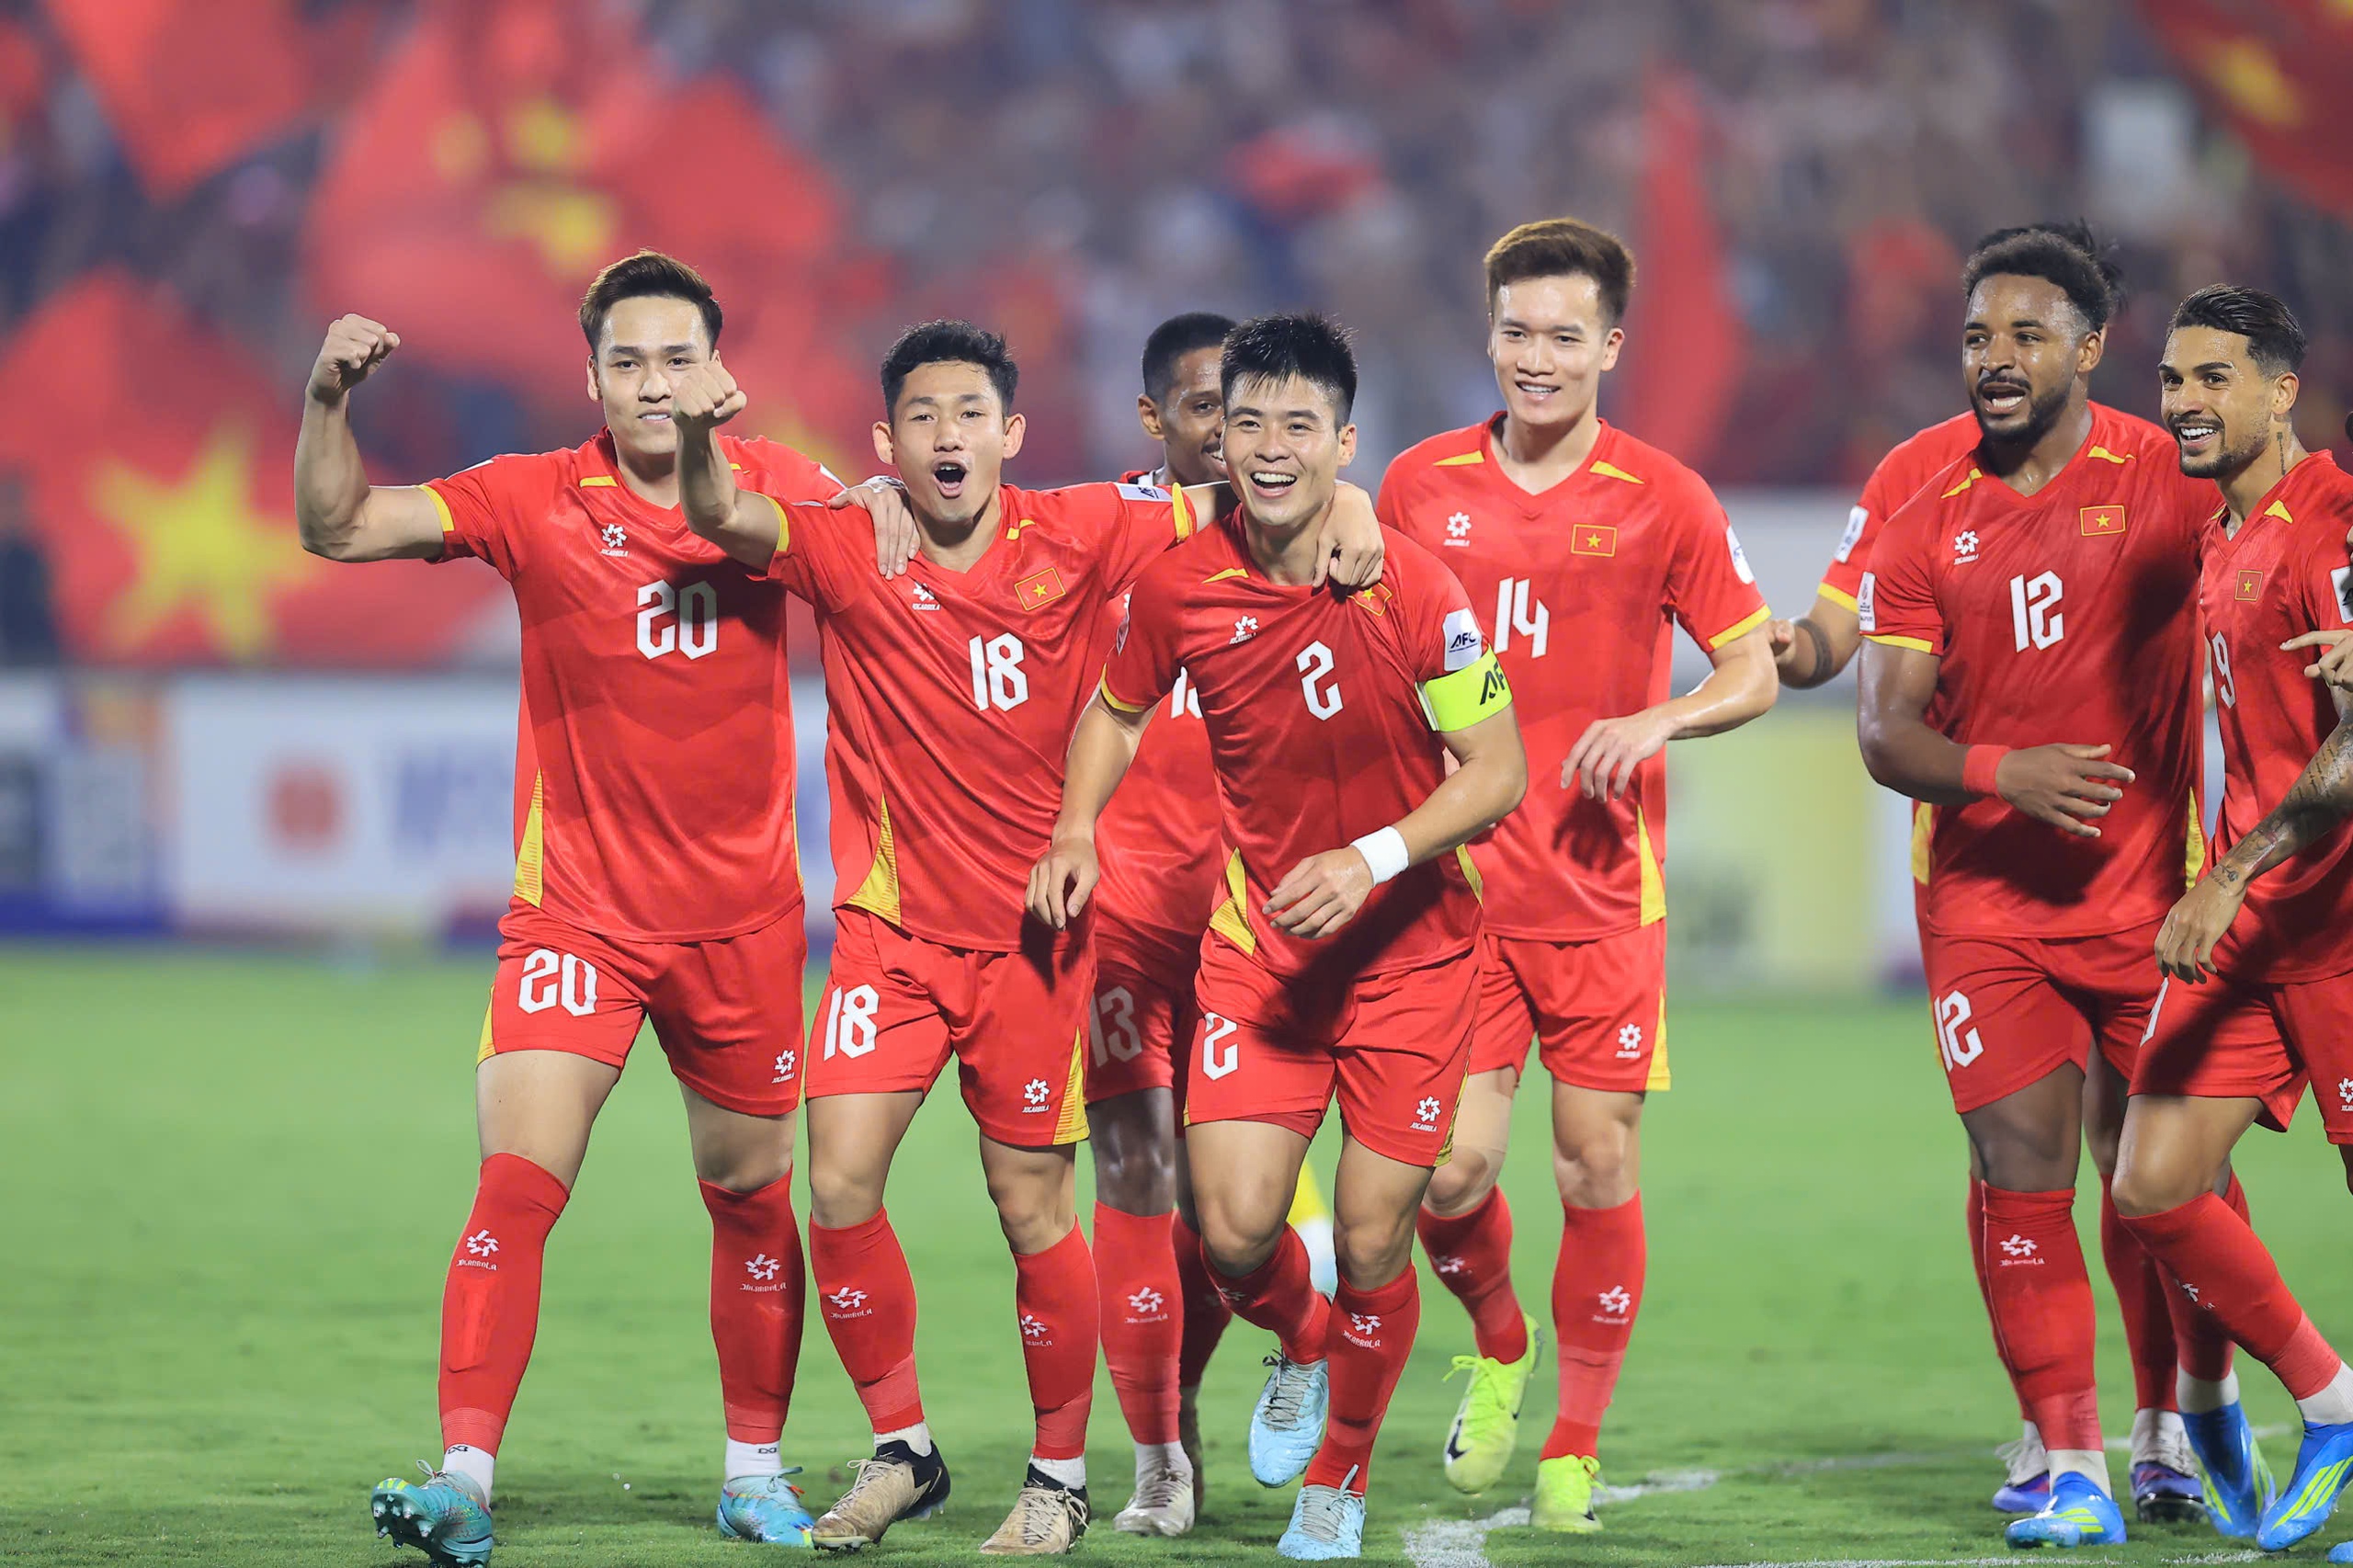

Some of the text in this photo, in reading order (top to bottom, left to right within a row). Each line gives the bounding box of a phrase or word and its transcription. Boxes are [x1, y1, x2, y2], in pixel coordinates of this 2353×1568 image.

[636, 579, 719, 661] 20
[1494, 576, 1551, 659] 14
[2010, 569, 2064, 653] 12
[968, 632, 1029, 712] 18
[1295, 640, 1344, 722] 2
[517, 949, 598, 1017] 20
[824, 983, 881, 1062] 18
[1088, 985, 1142, 1068] 13
[1202, 1011, 1239, 1082] 2
[1933, 990, 1984, 1073] 12
